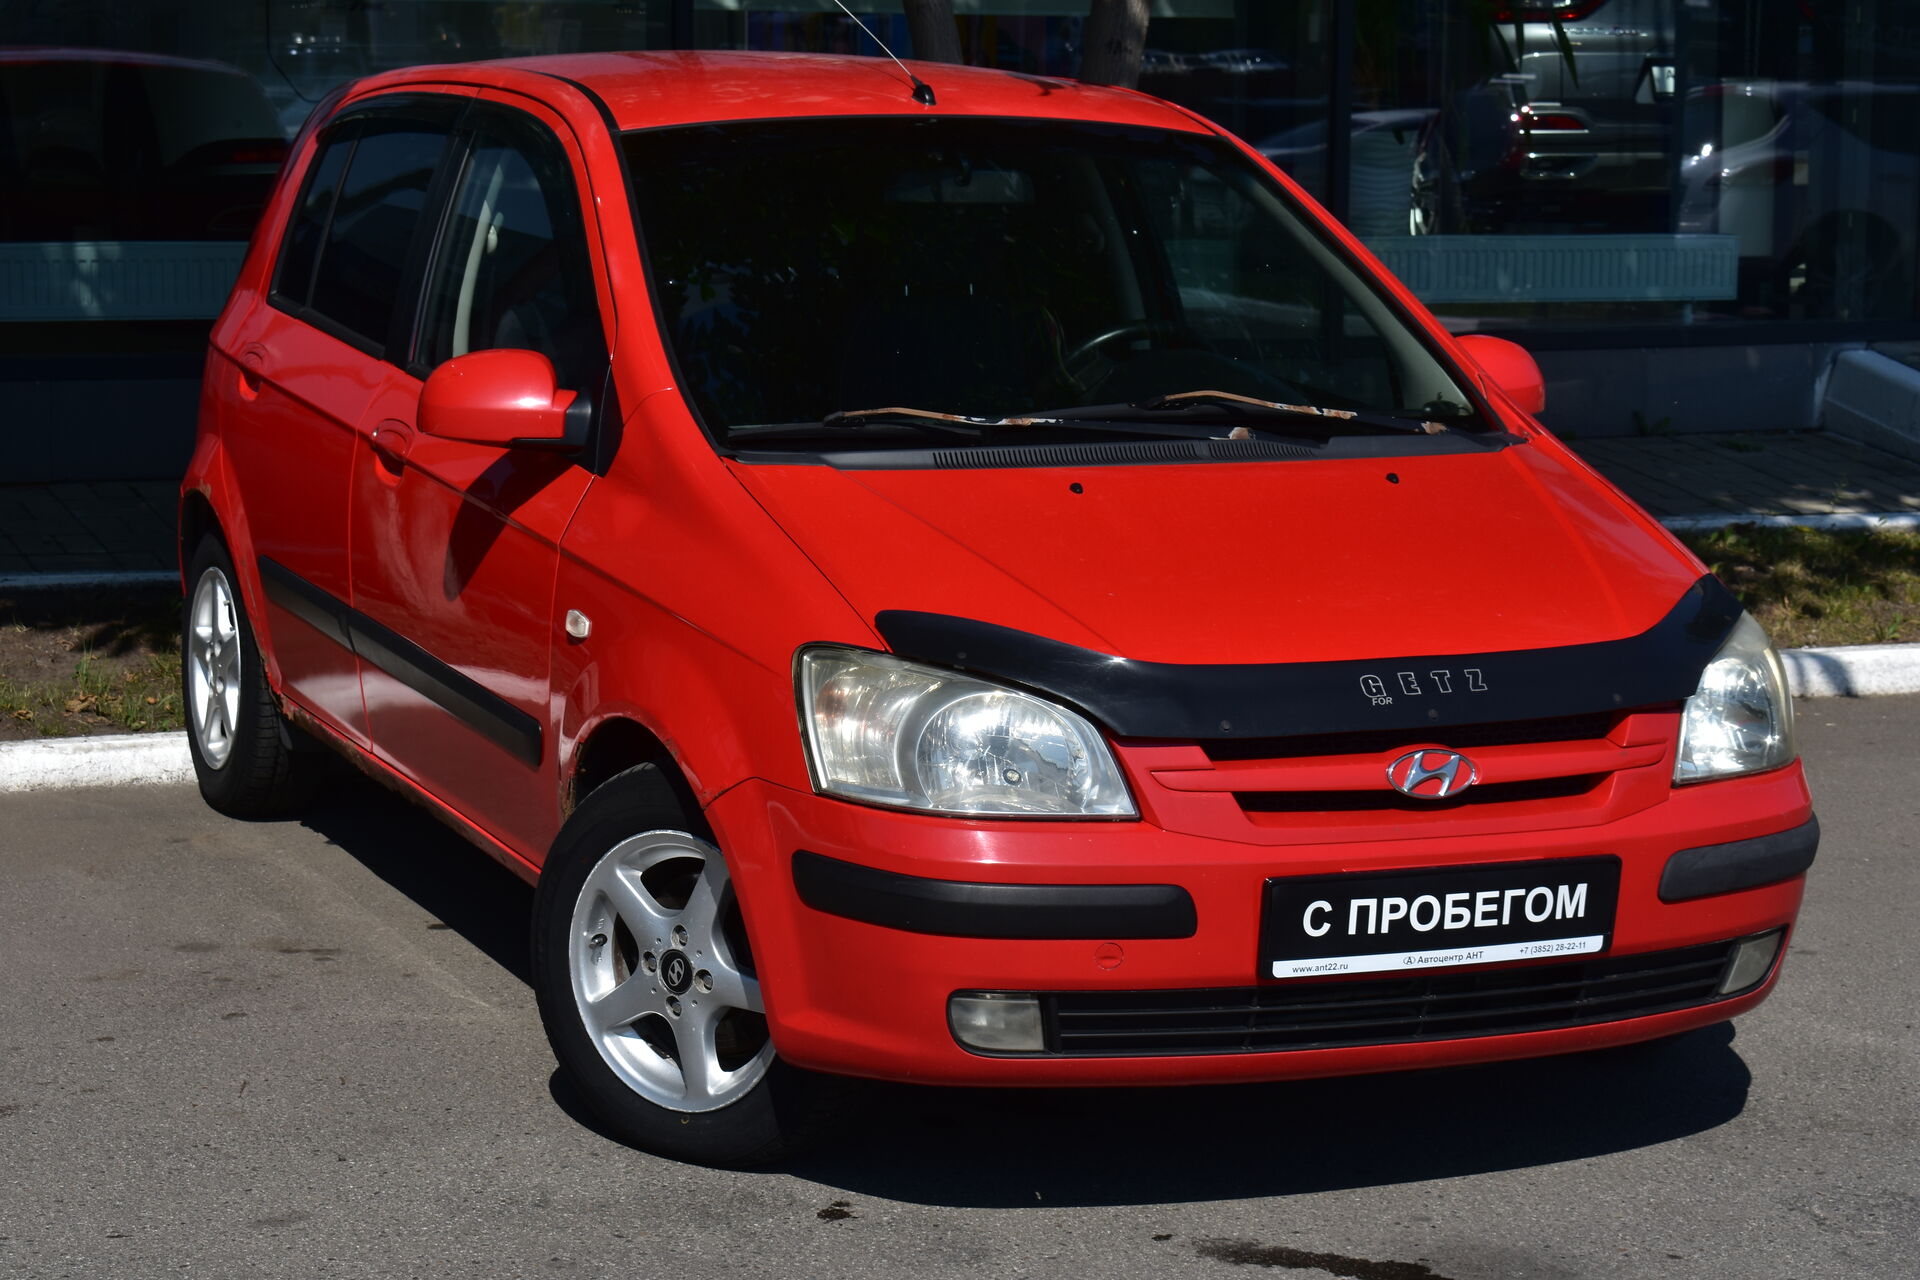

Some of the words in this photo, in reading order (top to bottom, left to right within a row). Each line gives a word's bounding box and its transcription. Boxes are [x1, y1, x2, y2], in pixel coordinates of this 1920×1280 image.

[1360, 669, 1488, 698] GETZ
[1372, 697, 1393, 706] FOR
[1303, 900, 1333, 937] С
[1348, 883, 1588, 935] ПРОБЕГОМ
[1531, 944, 1554, 955] (3852)
[1555, 942, 1587, 951] 28-22-11
[1417, 954, 1464, 964] Автоцентр
[1465, 951, 1484, 960] АНТ
[1292, 963, 1349, 973] www.ant22.ru
